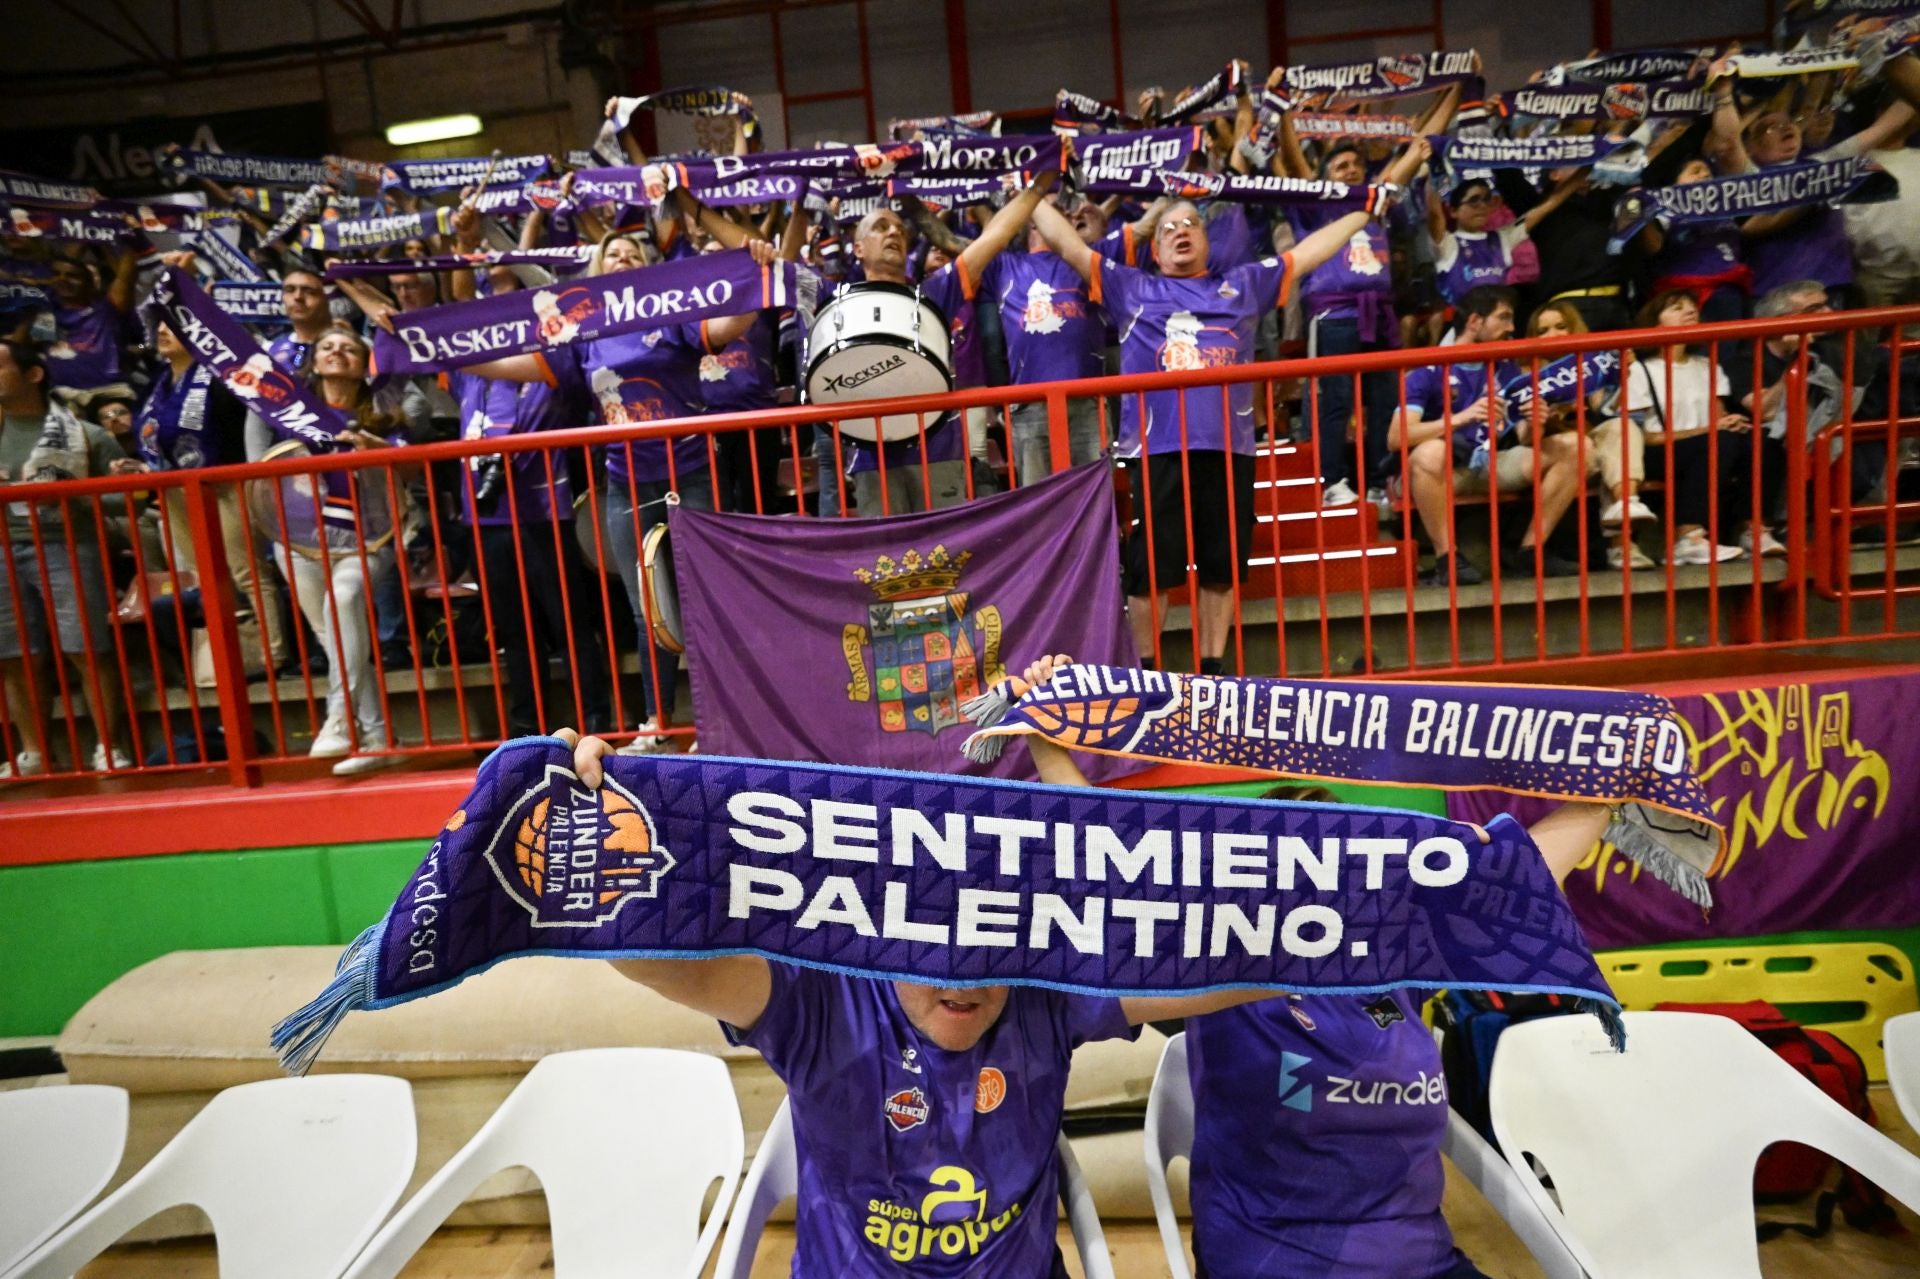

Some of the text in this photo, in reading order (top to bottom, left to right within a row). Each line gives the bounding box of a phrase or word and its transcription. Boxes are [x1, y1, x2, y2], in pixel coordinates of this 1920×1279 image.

[1515, 91, 1599, 118] Siempre
[1083, 134, 1182, 169] Contigo
[1451, 143, 1595, 162] SENTIMIENT
[337, 213, 420, 238] PALENCIA
[214, 288, 282, 301] SENTI
[399, 319, 530, 363] BASKET
[603, 279, 732, 327] MORAO
[832, 354, 904, 388] ROCKSTAR
[846, 642, 869, 694] ARMAS
[985, 612, 999, 678] CIENCIA
[1014, 664, 1166, 707] LENCIA
[1190, 678, 1686, 776] PALENCIA BALONCESTO
[546, 805, 569, 894] PALENCIA
[563, 785, 599, 911] ZUNDER
[726, 790, 1470, 891] SENTIMIENTO
[408, 841, 448, 974] endesa
[728, 863, 1369, 959] PALENTINO.
[886, 1101, 926, 1121] PALENCIA
